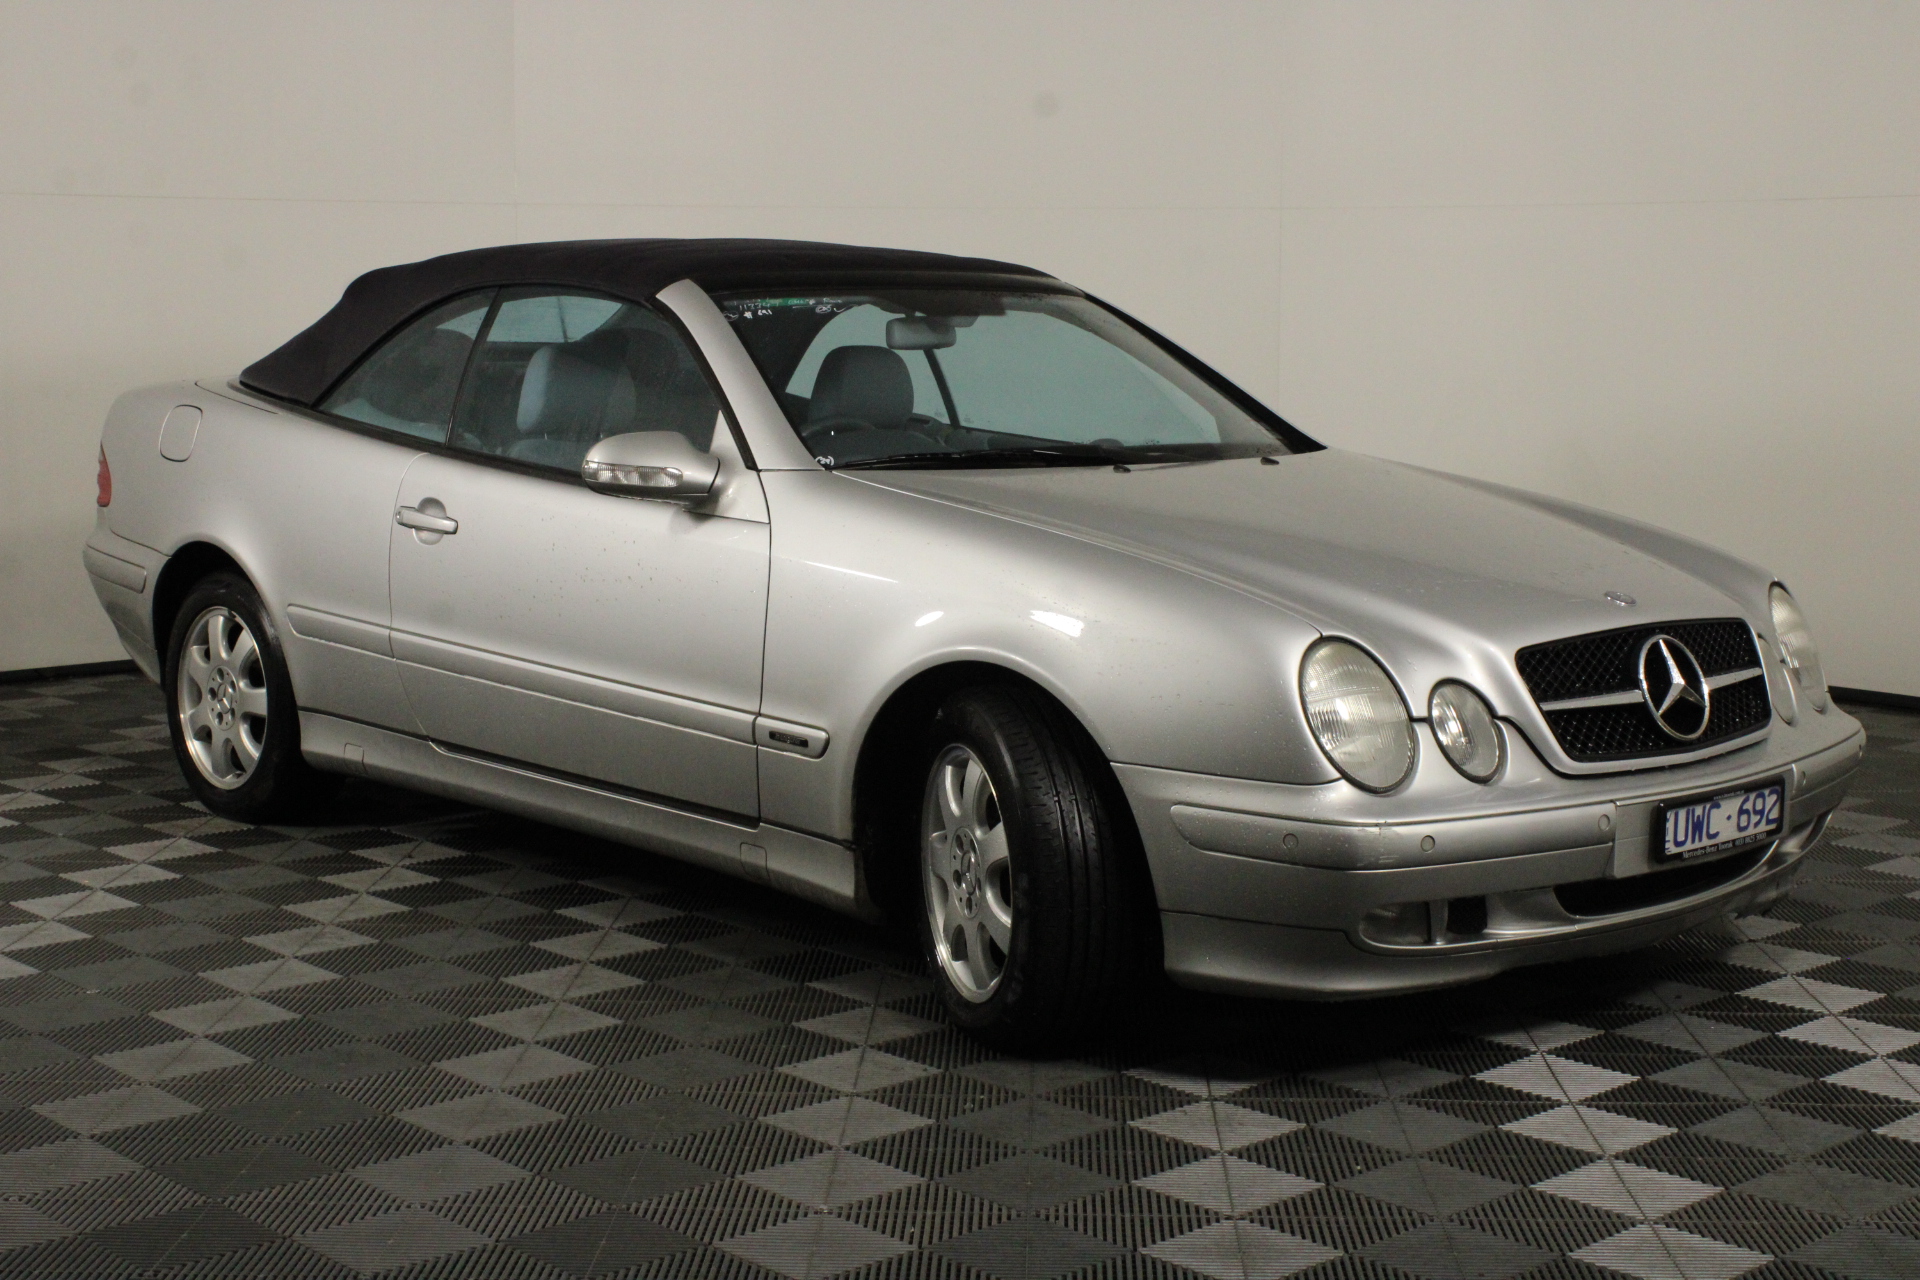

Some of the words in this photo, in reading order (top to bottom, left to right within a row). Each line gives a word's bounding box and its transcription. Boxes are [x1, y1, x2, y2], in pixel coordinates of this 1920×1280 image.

[1673, 801, 1721, 848] UWC
[1737, 787, 1781, 833] 692
[1683, 845, 1718, 859] Mercedes-Benz
